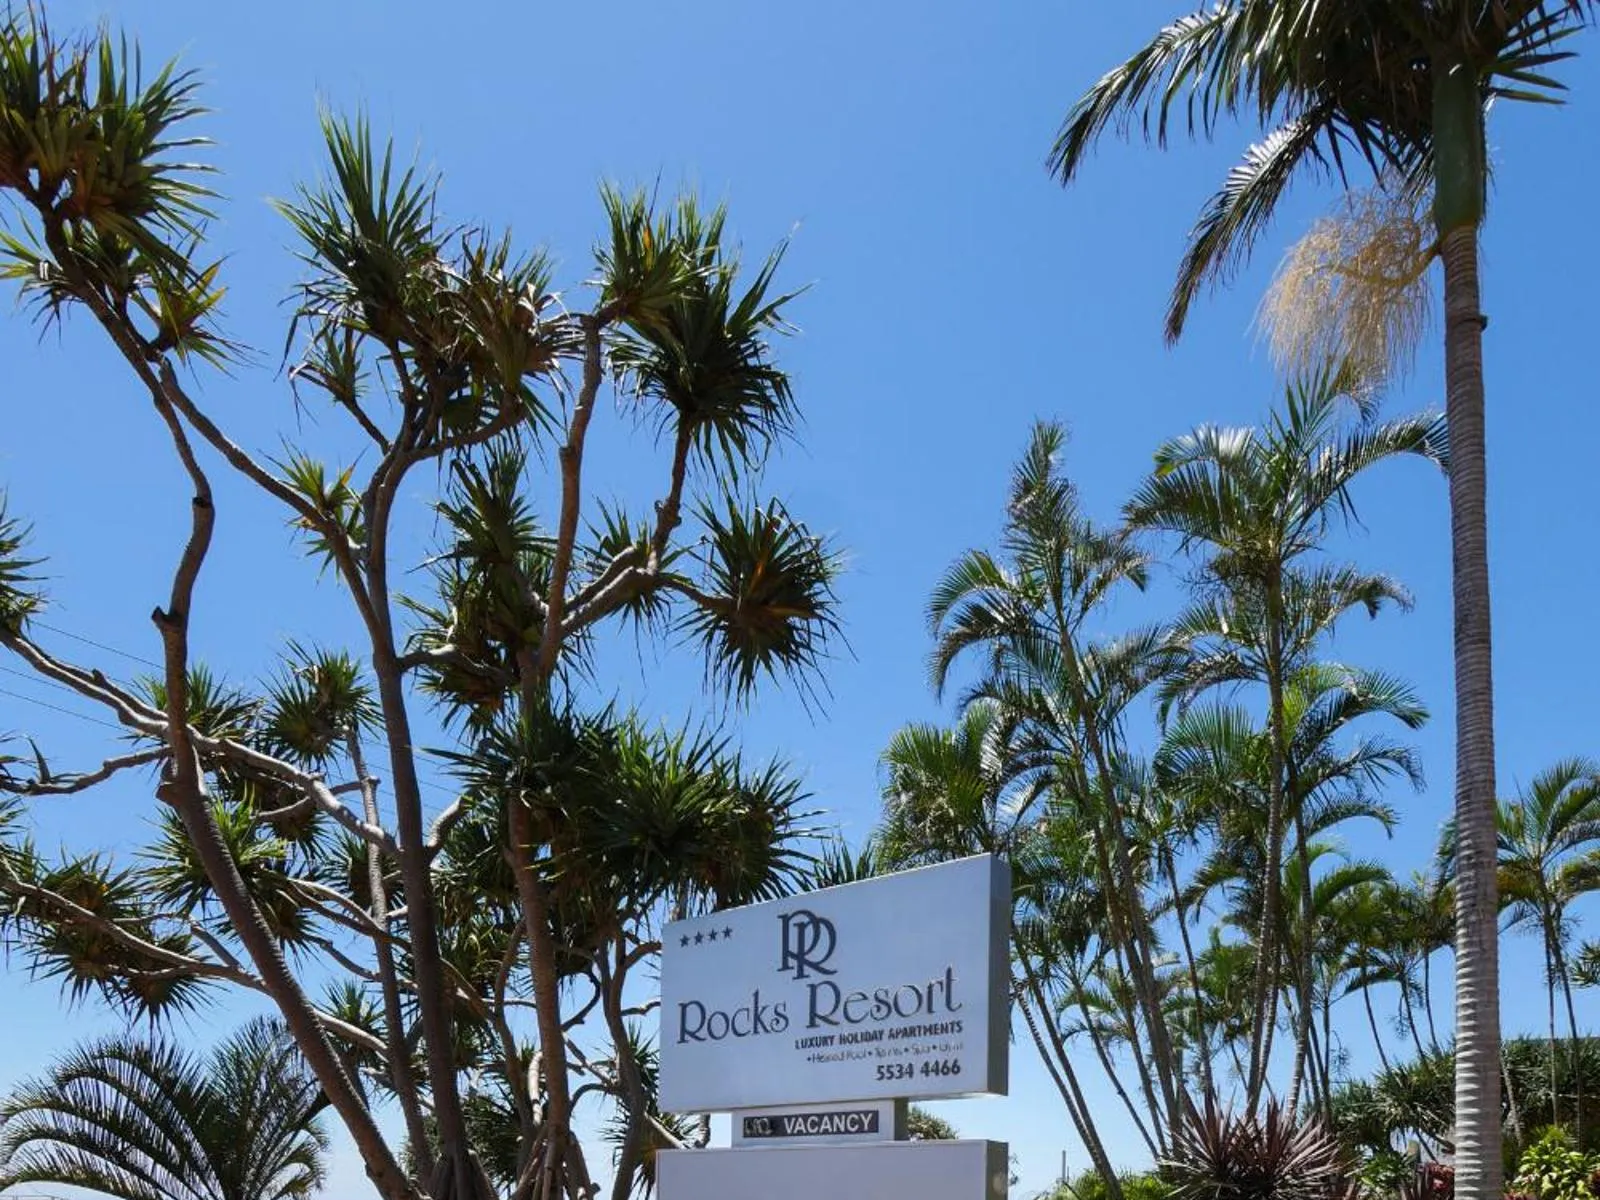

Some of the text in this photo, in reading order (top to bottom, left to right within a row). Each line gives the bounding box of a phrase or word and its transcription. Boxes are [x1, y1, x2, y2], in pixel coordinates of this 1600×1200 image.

[677, 966, 963, 1044] Rocks Resort
[795, 1020, 963, 1050] LUXURY HOLIDAY APARTMENTS
[876, 1059, 961, 1081] 5534 4466
[783, 1112, 873, 1135] VACANCY
